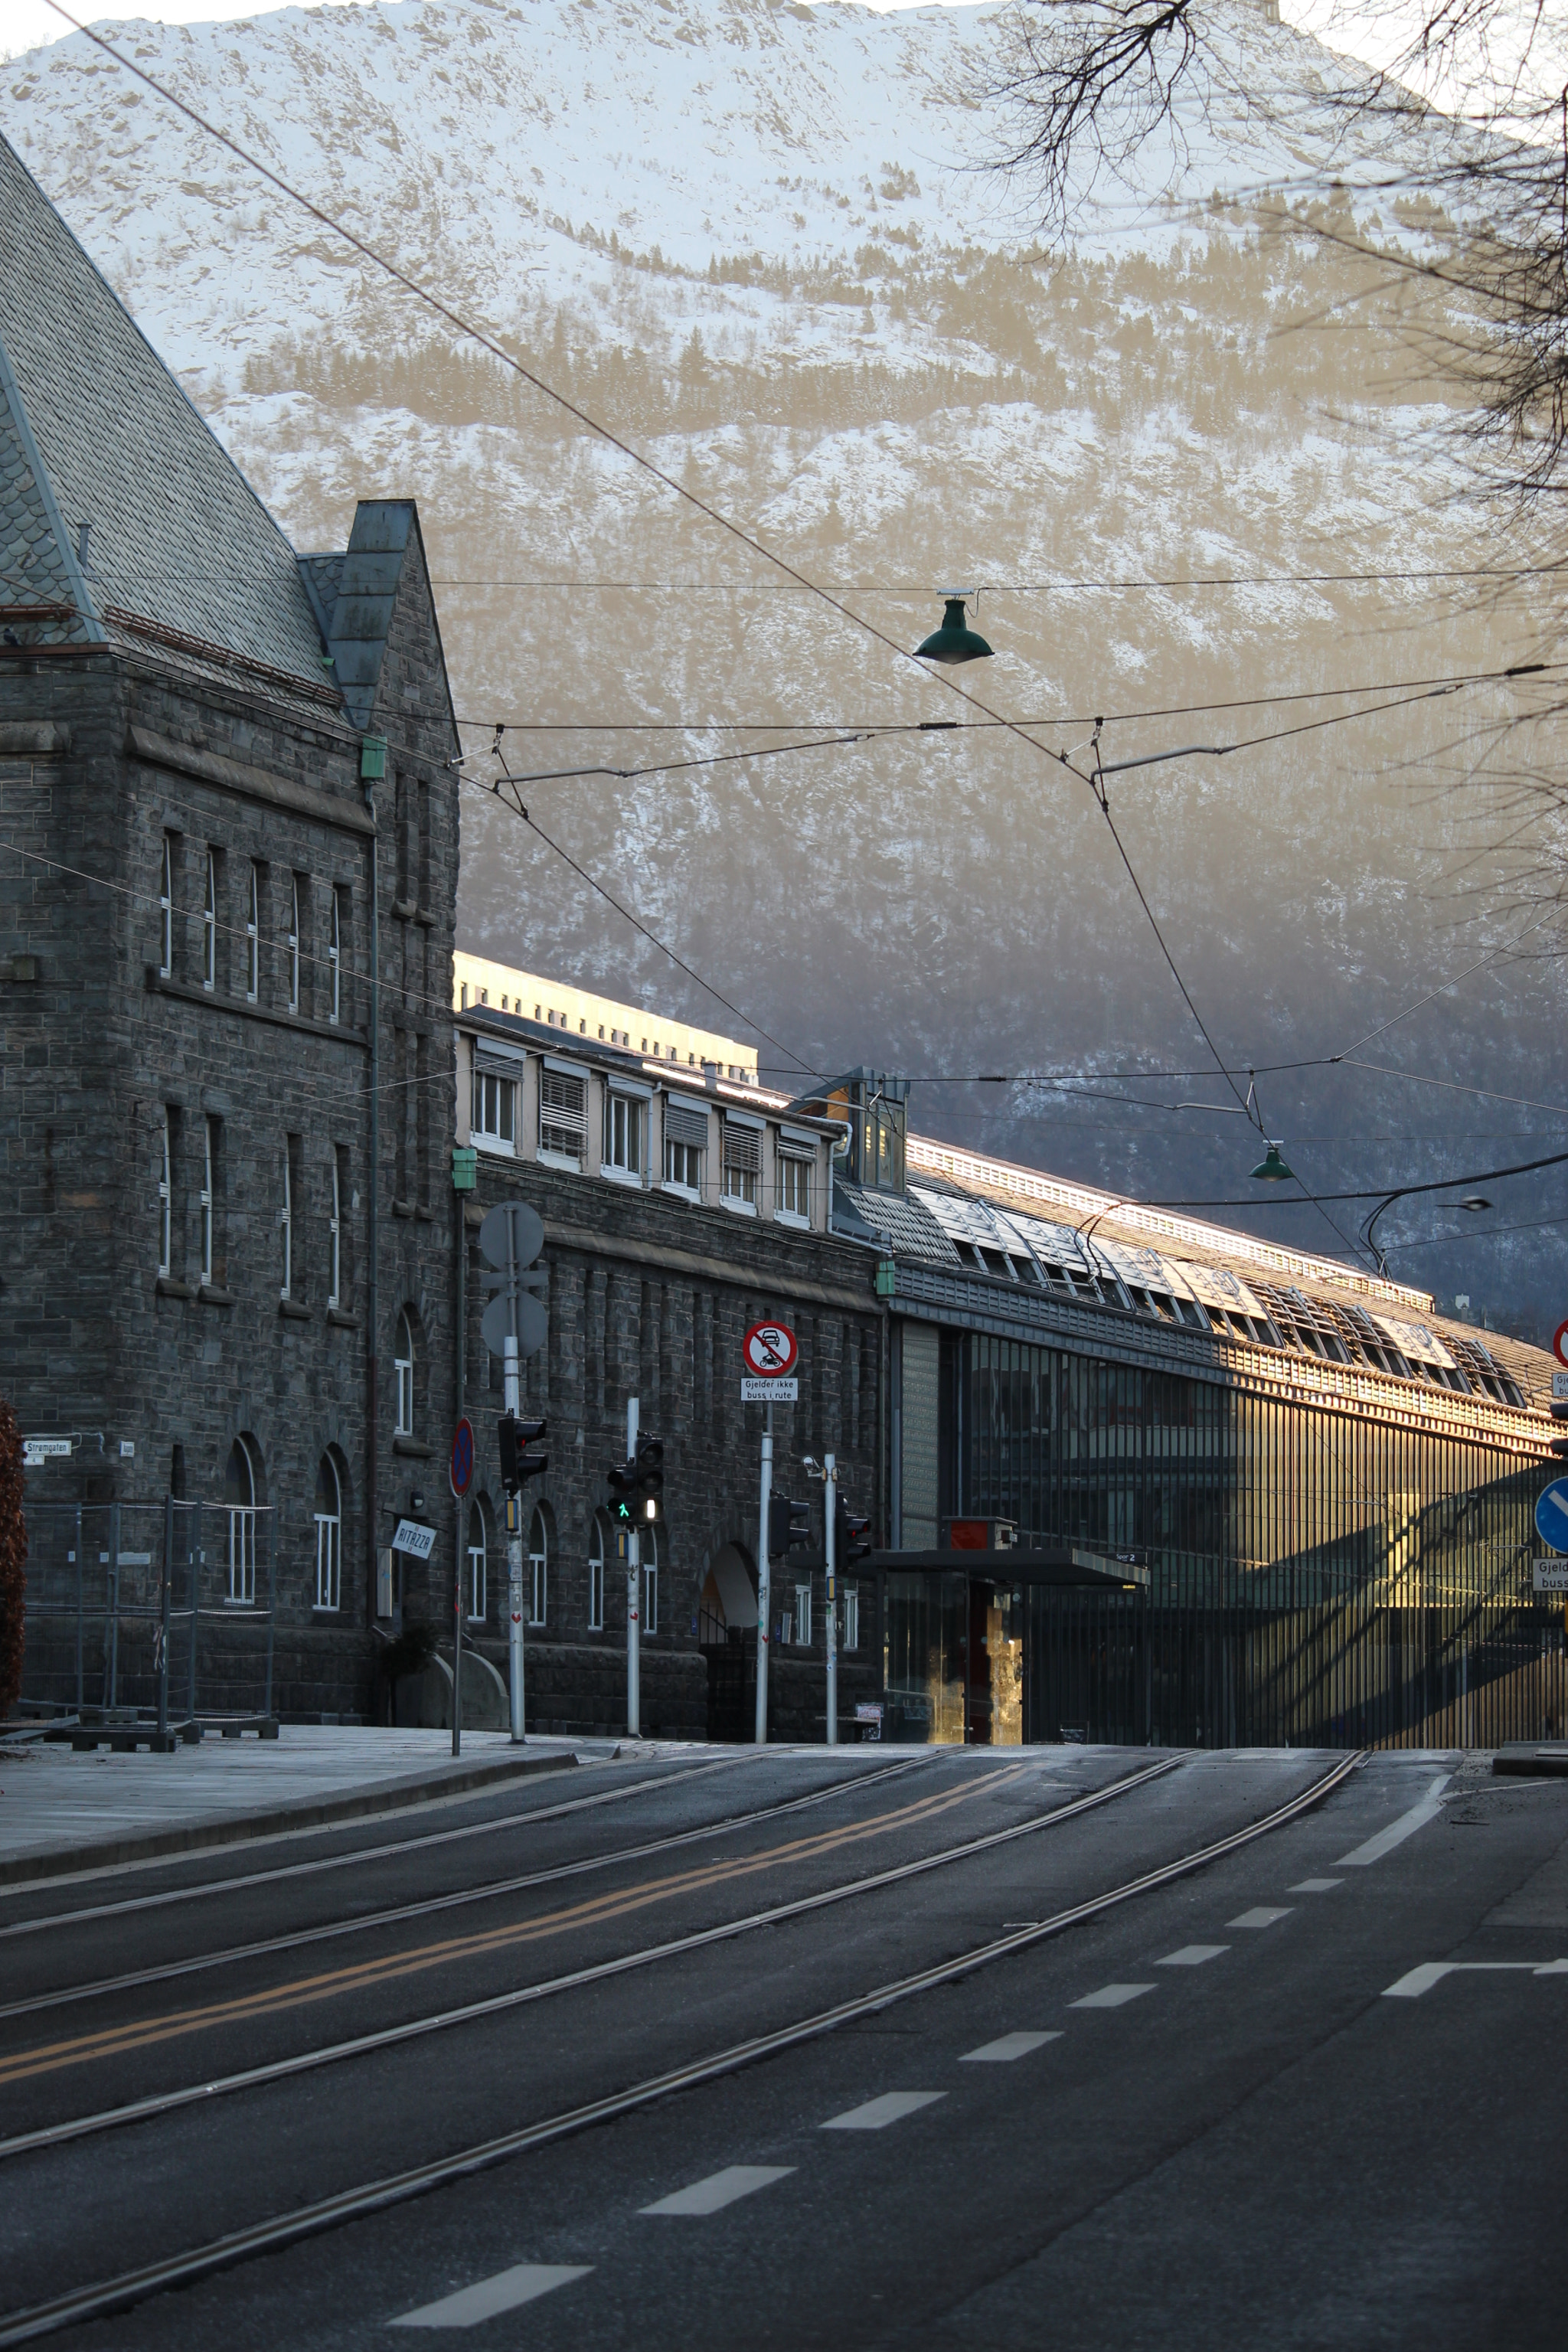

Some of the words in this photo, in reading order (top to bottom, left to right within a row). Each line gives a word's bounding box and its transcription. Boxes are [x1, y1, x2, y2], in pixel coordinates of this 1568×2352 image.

[745, 1380, 774, 1390] Gjelder
[777, 1380, 793, 1388] ikke
[28, 1443, 67, 1453] Strømgaten
[398, 1528, 430, 1550] RITAZZA
[1542, 1577, 1568, 1588] buss
